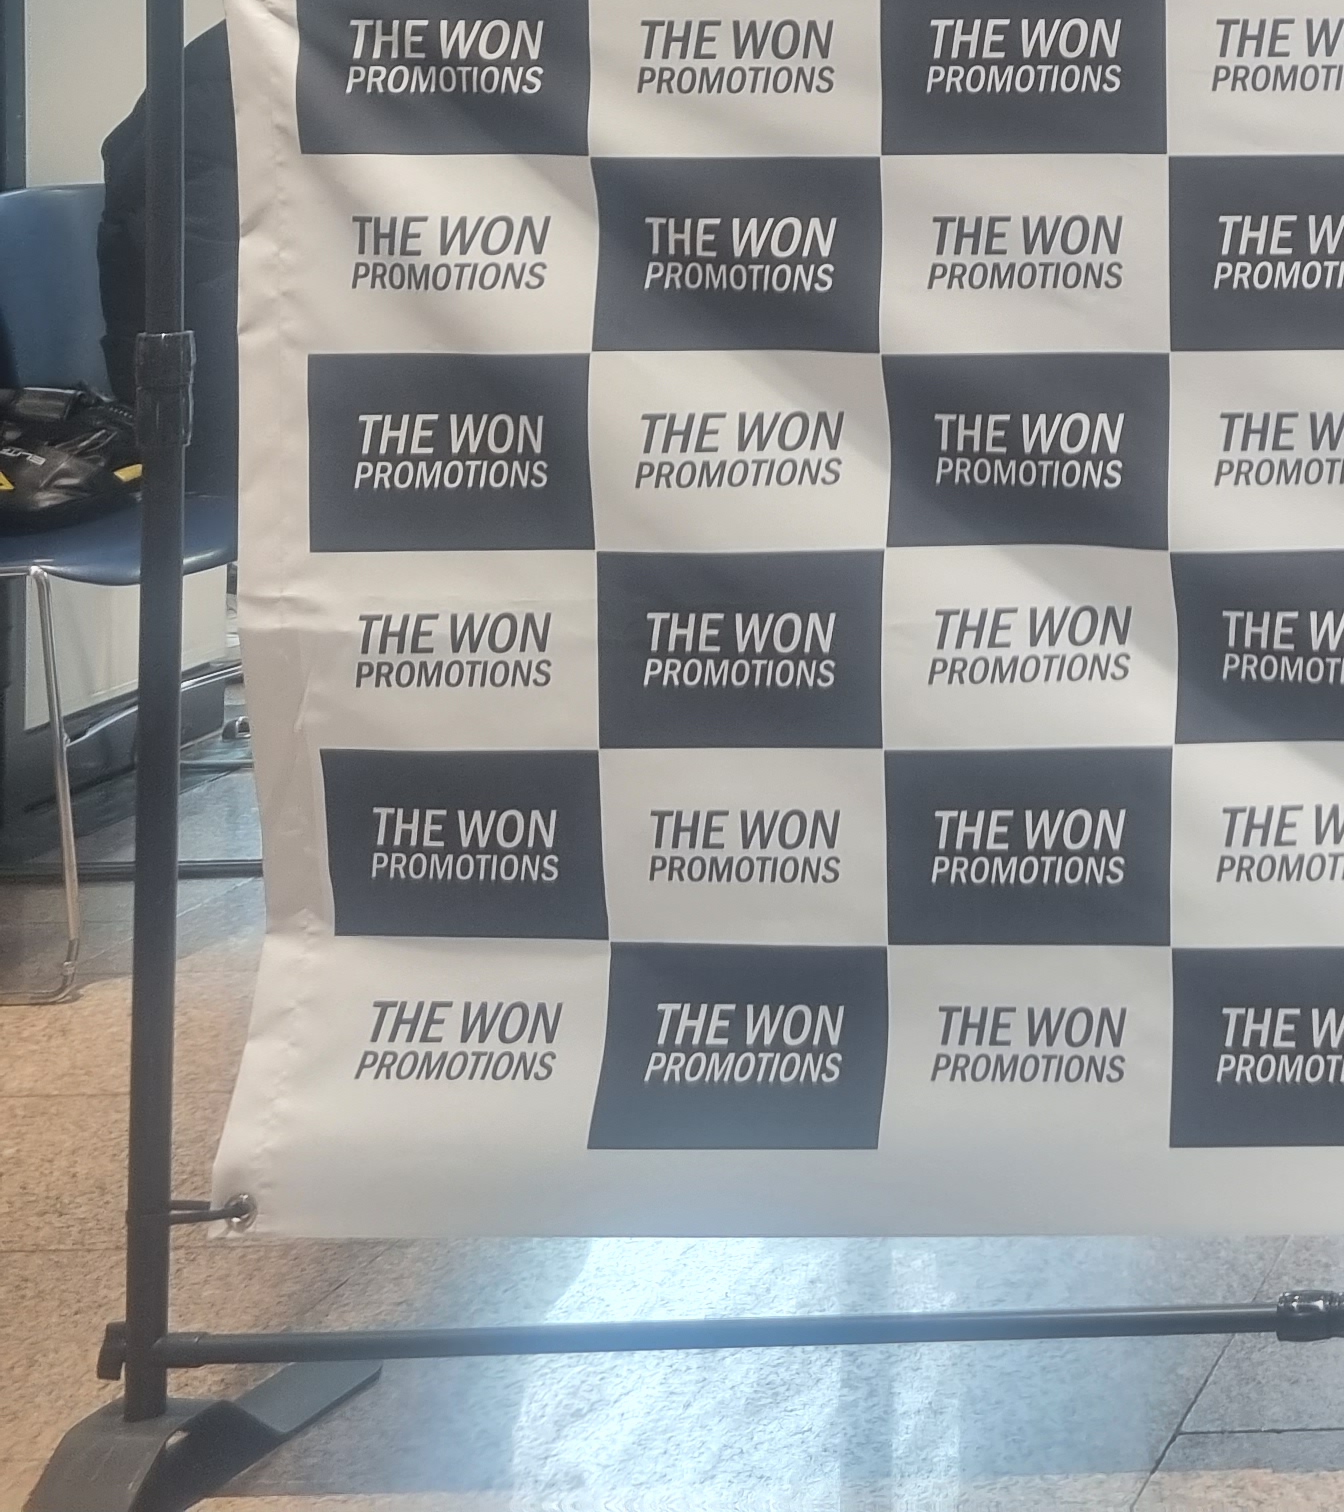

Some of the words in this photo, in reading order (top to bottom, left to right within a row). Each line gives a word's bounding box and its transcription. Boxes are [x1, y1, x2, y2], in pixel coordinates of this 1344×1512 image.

[929, 18, 1011, 60] THE
[1020, 17, 1122, 60] WON
[925, 64, 1122, 94] PROMOTIONS
[351, 215, 429, 257] THE
[439, 215, 552, 257] WON
[931, 215, 1012, 257] THE
[1021, 214, 1124, 256] WON
[351, 261, 548, 292] PROMOTIONS
[926, 261, 1124, 291] PROMOTIONS
[358, 413, 440, 456] THE
[449, 413, 544, 455] WON
[1219, 411, 1300, 453] THE
[353, 459, 549, 490] PROMOTIONS
[646, 611, 725, 653] THE
[734, 611, 837, 655] WON
[1221, 610, 1300, 651] THE
[642, 657, 836, 689] PROMOTIONS
[649, 809, 730, 850] THE
[739, 808, 841, 851] WON
[933, 809, 1015, 852] THE
[1024, 808, 1127, 851] WON
[648, 855, 841, 884] PROMOTIONS
[930, 855, 1126, 886] PROMOTIONS
[938, 1005, 1017, 1047] THE
[1027, 1006, 1127, 1049] WON
[1221, 1007, 1301, 1049] THE
[930, 1052, 1126, 1084] PROMOTIONS
